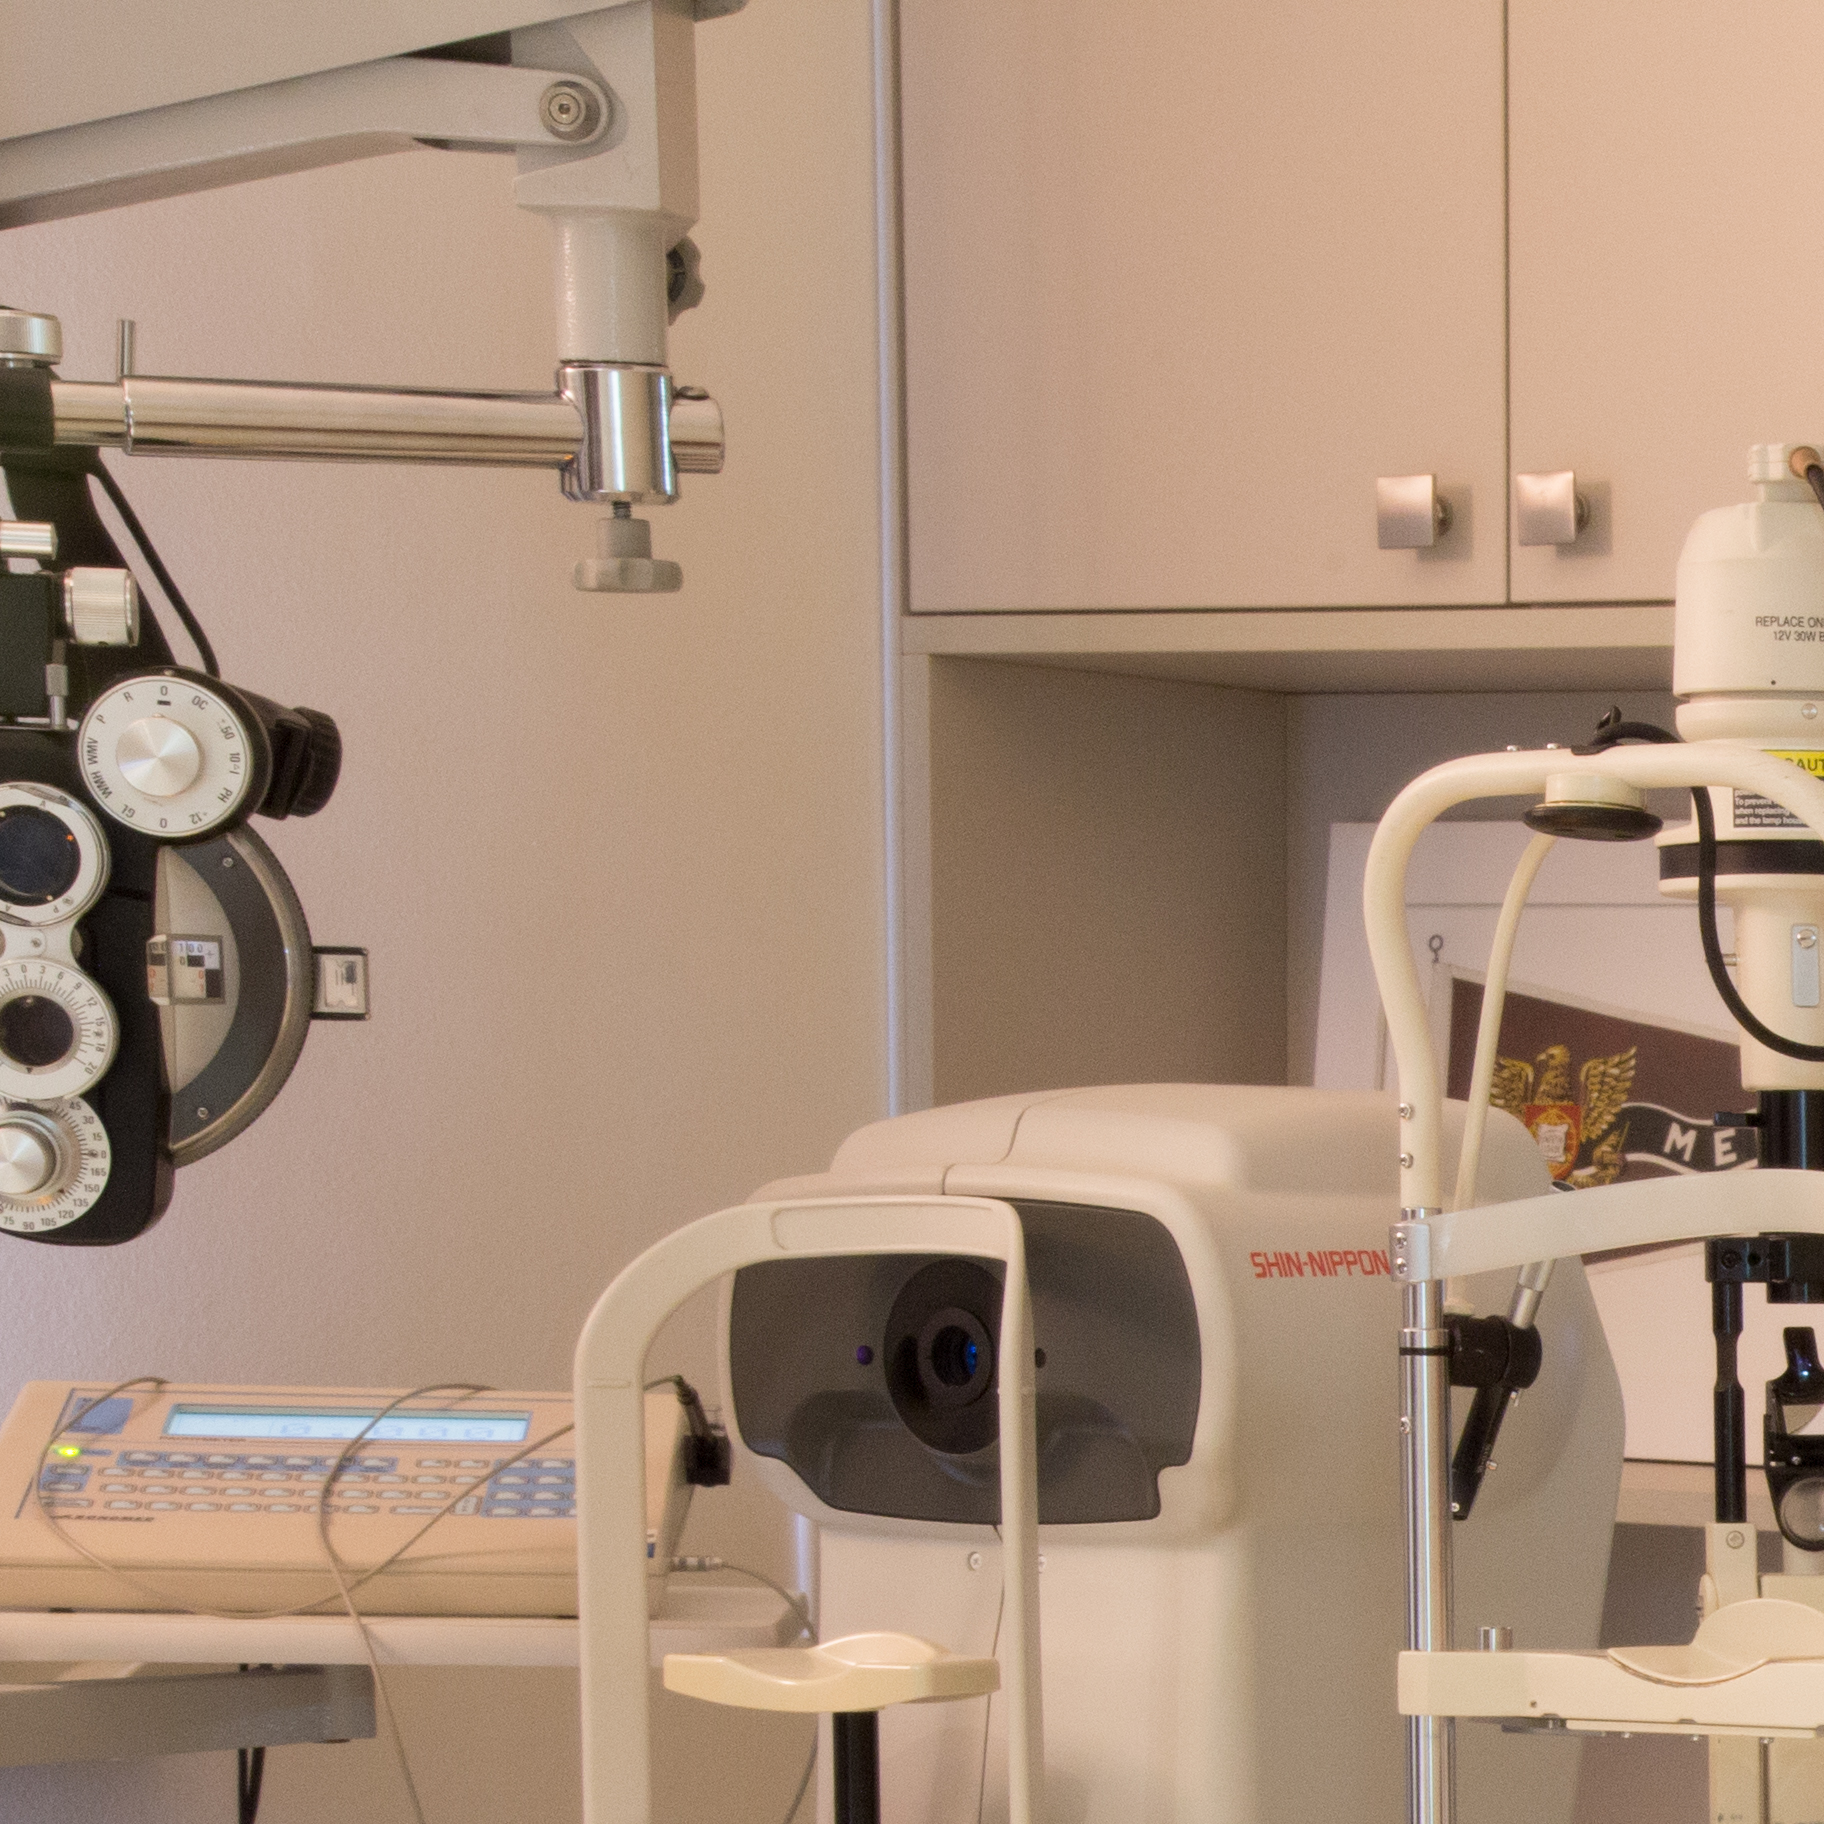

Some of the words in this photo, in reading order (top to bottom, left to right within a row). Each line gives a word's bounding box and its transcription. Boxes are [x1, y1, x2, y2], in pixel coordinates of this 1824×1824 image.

[1755, 616, 1805, 628] REPLACE
[1774, 630, 1791, 641] 12V
[1794, 631, 1816, 642] 30W
[123, 691, 134, 703] R
[95, 714, 107, 725] P
[86, 737, 99, 766] WMV
[90, 771, 113, 800] WMH
[217, 787, 234, 804] PH
[121, 804, 136, 819] GL
[69, 1101, 82, 1111] 45
[82, 1115, 95, 1125] 30
[84, 1183, 101, 1193] 150
[58, 1209, 75, 1219] 120
[22, 1222, 35, 1231] 90
[40, 1218, 57, 1227] 105
[1250, 1250, 1391, 1279] SHIN-NIPPON
